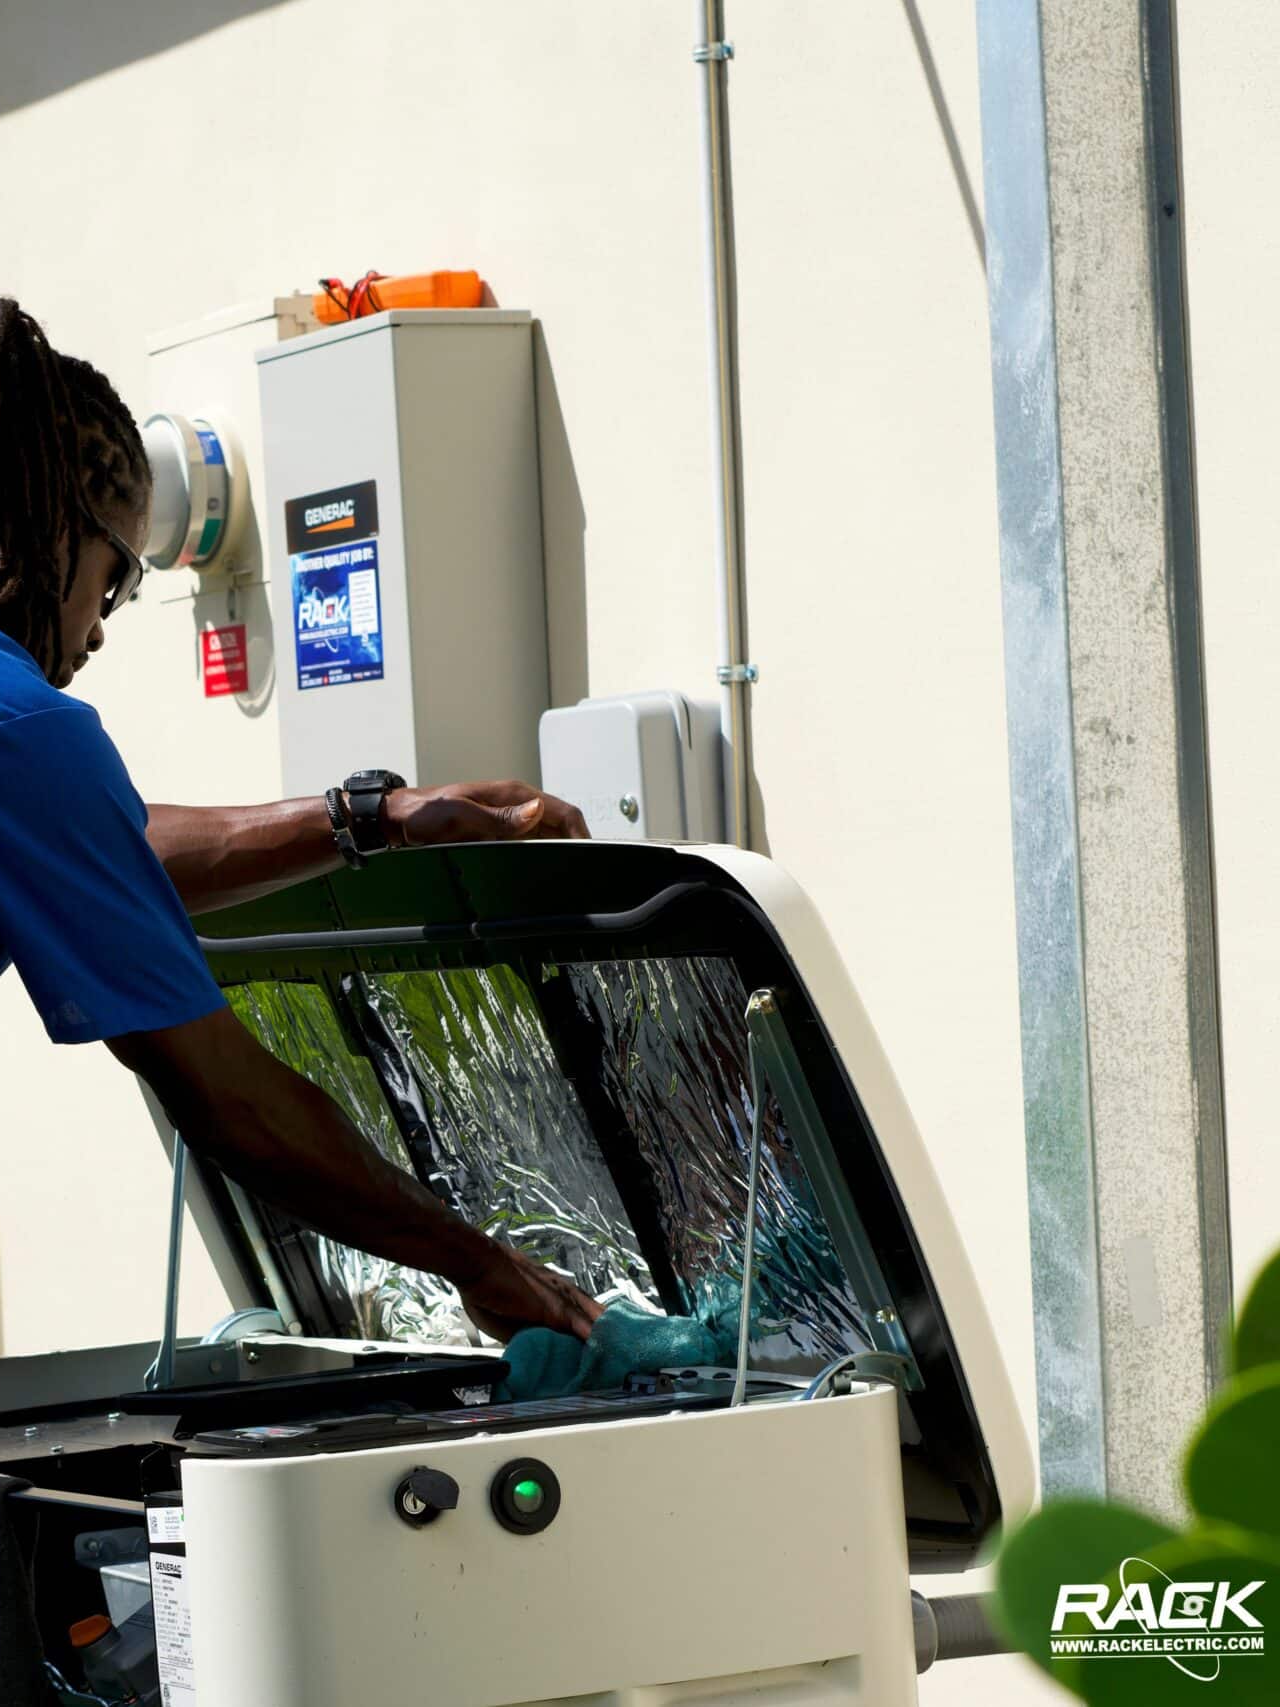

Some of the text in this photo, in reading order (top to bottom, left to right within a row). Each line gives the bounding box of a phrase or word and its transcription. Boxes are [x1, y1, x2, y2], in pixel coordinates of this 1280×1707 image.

[305, 499, 354, 527] GENERAC
[298, 595, 347, 629] RACK
[155, 1561, 182, 1573] GENERAC
